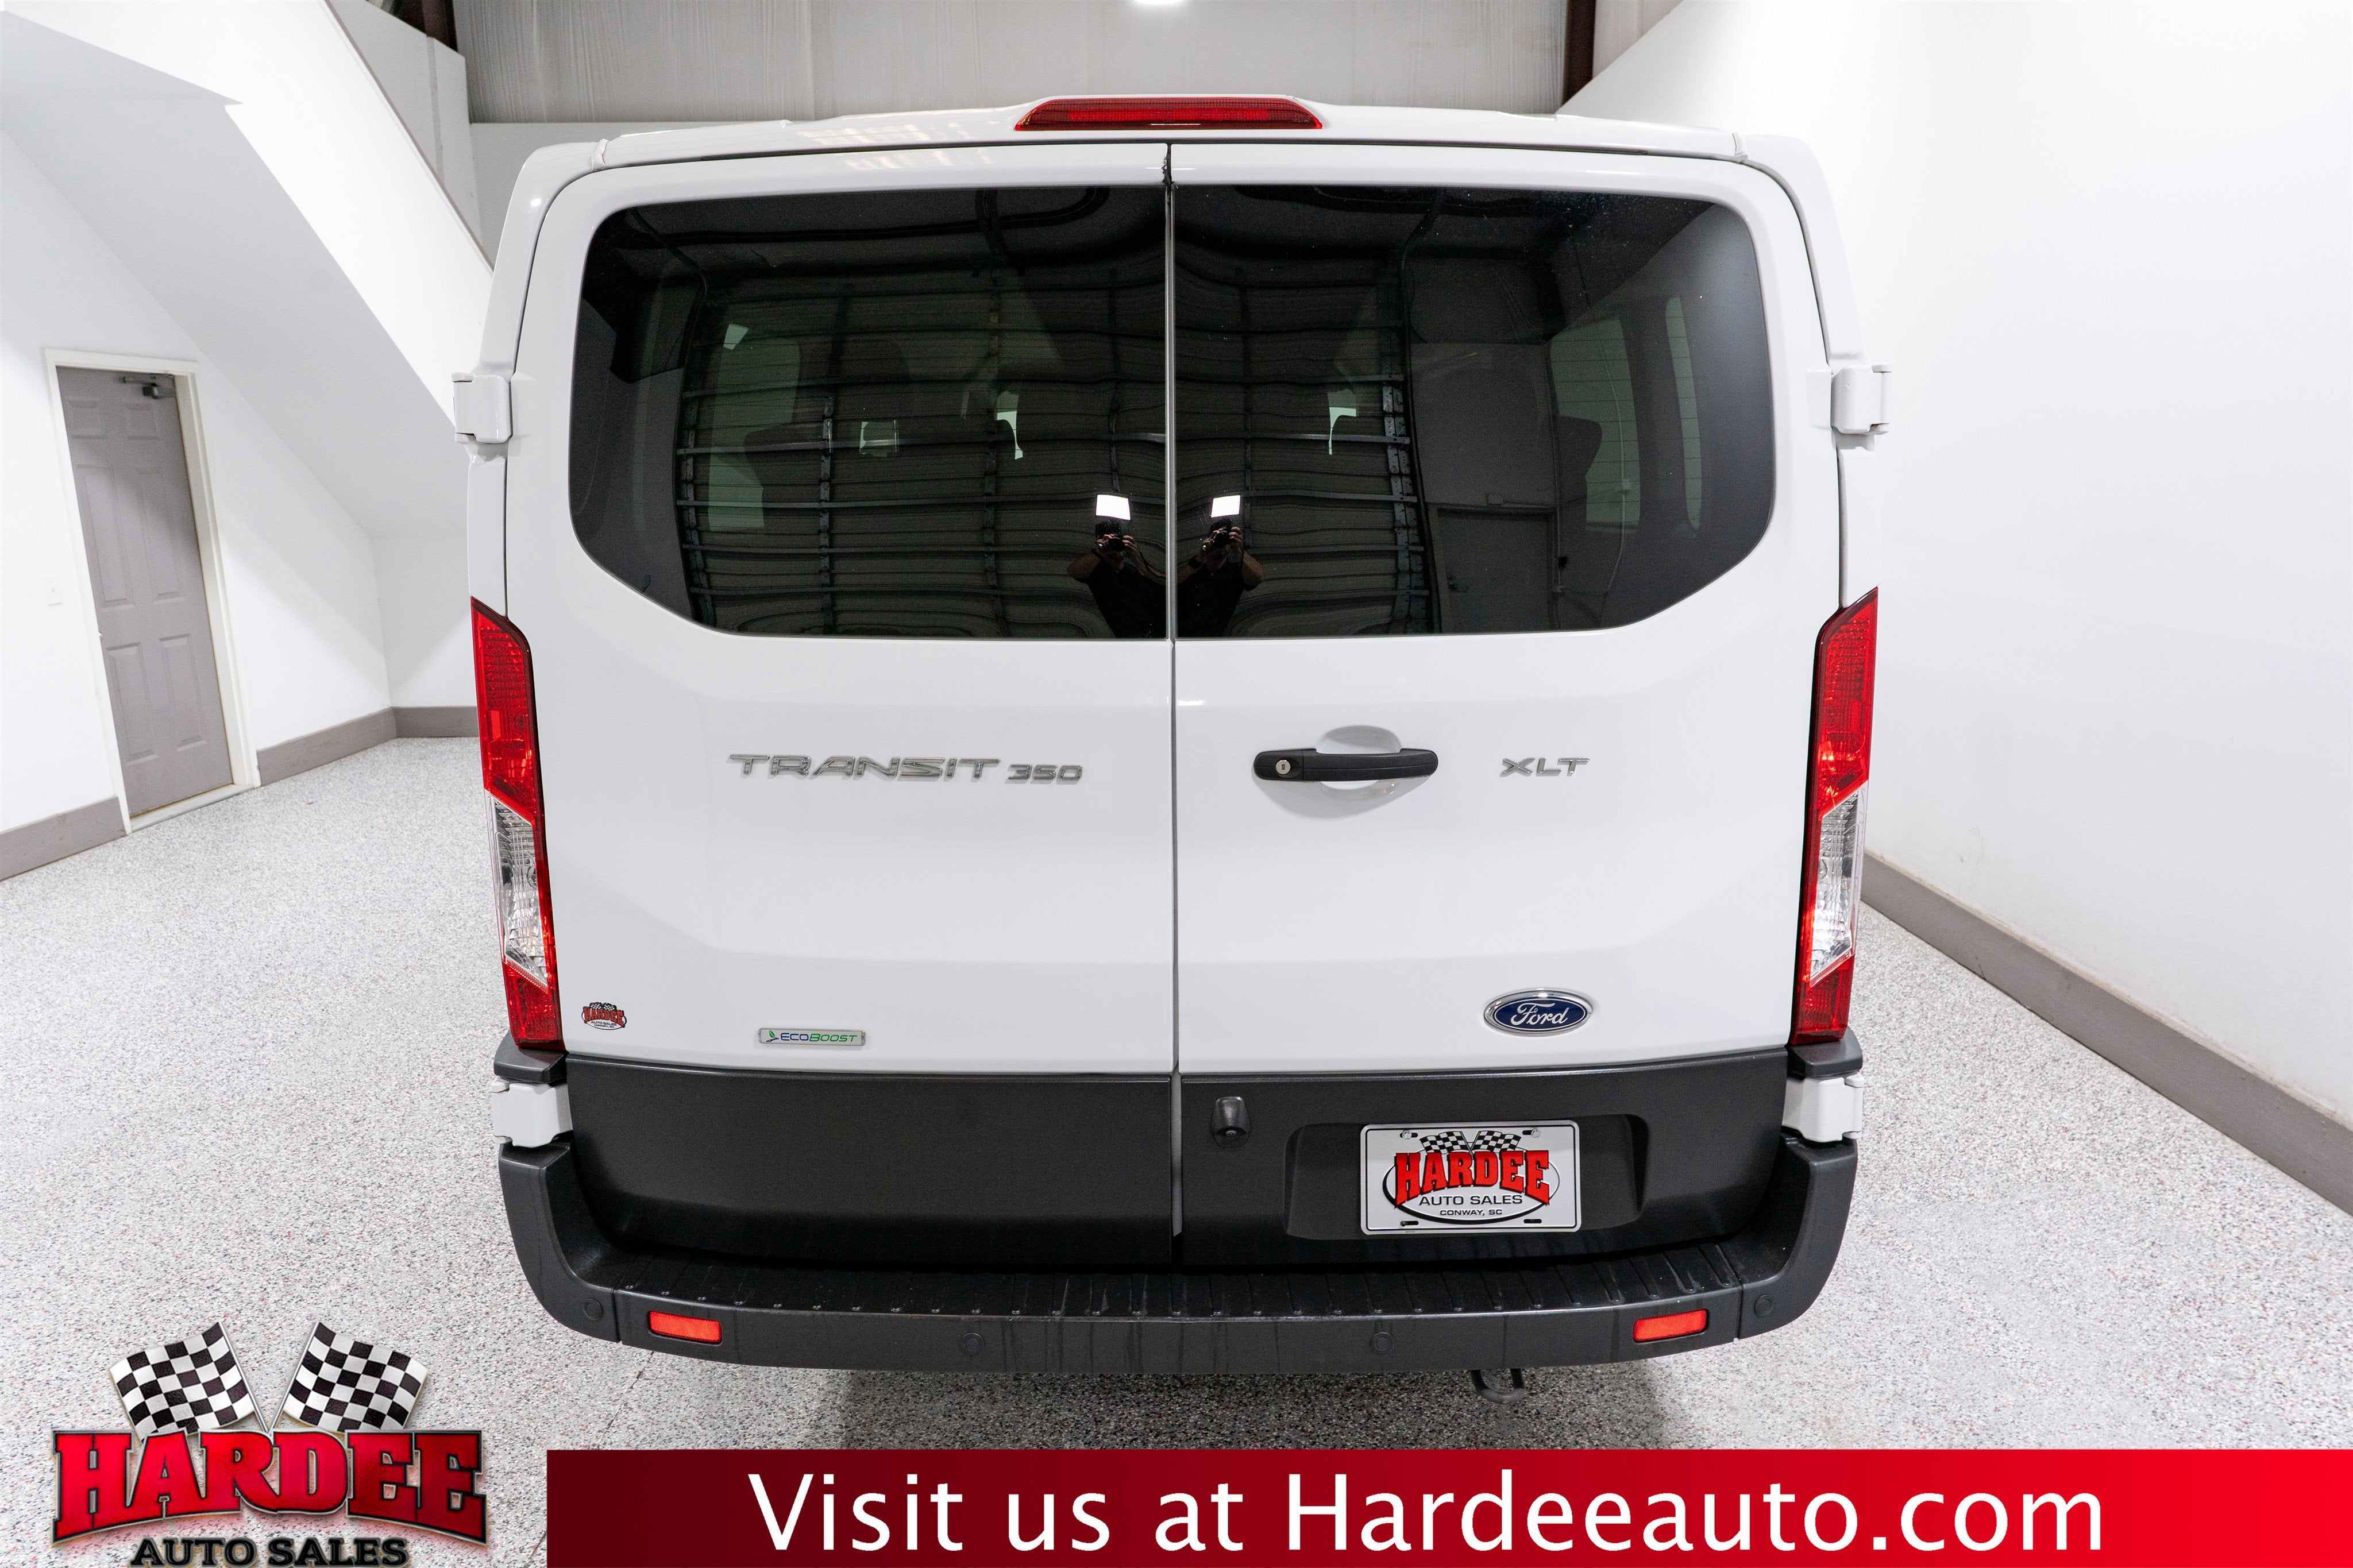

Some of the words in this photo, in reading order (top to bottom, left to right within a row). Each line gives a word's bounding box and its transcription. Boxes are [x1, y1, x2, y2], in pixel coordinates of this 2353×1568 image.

[729, 753, 1001, 778] TRANSIT
[1007, 764, 1082, 781] 350
[1500, 756, 1591, 777] XLT
[583, 1006, 626, 1028] HARDEE
[1510, 1002, 1569, 1026] Ford
[1395, 1150, 1550, 1207] HARDEE
[1418, 1196, 1464, 1206] AUTO
[1469, 1195, 1523, 1205] SALES
